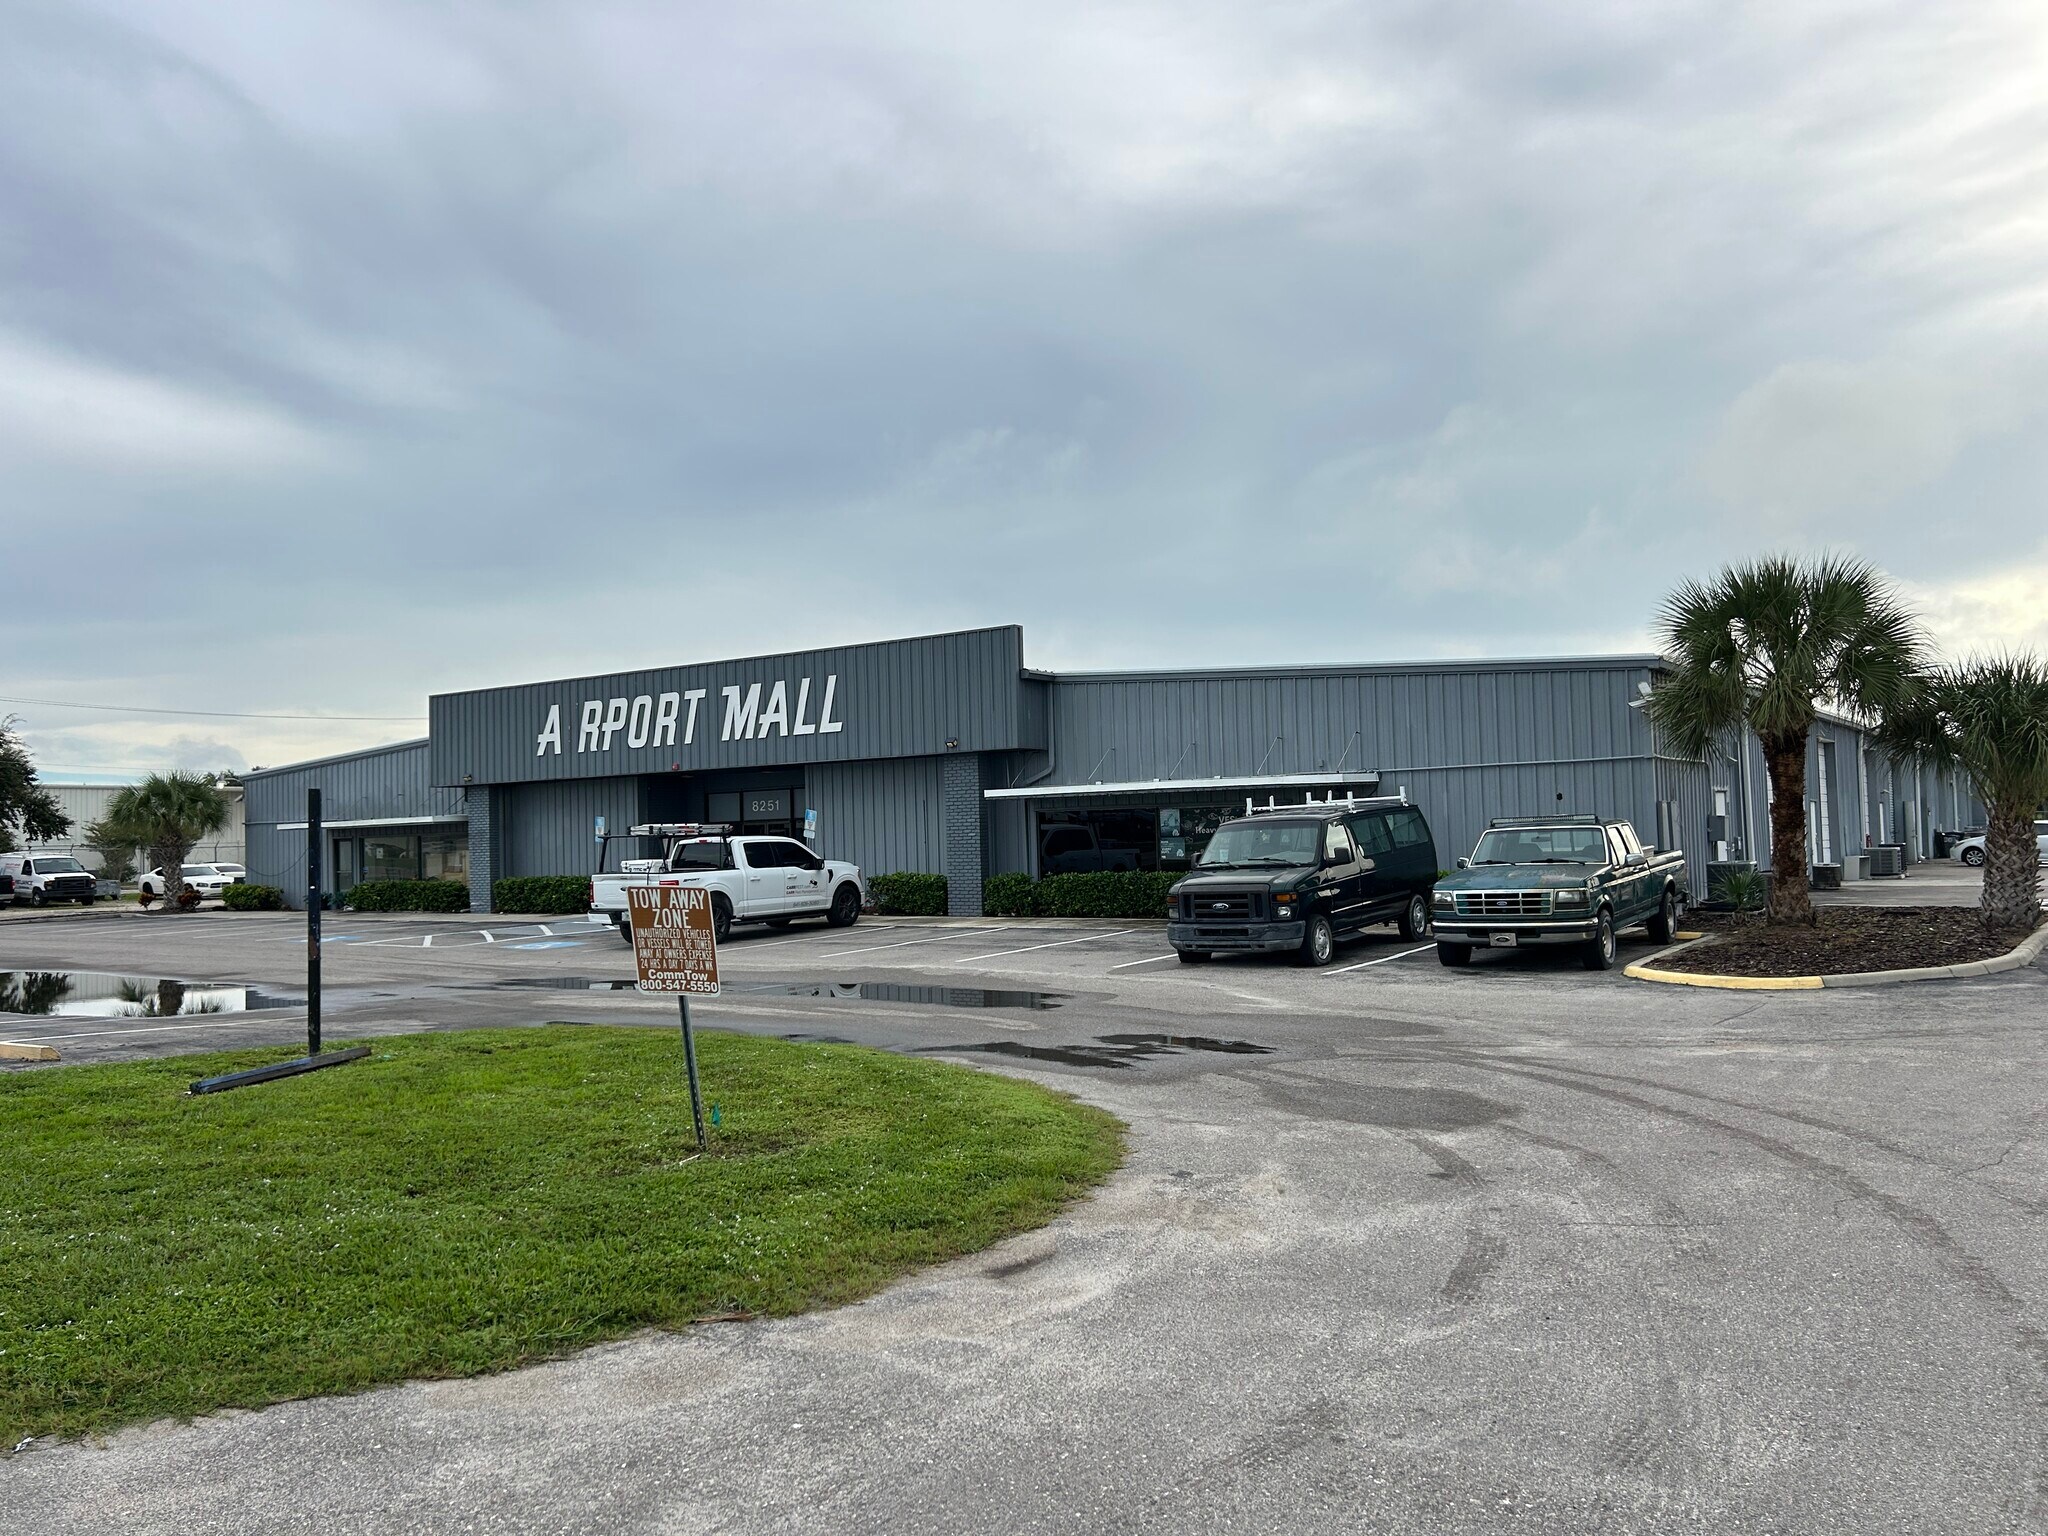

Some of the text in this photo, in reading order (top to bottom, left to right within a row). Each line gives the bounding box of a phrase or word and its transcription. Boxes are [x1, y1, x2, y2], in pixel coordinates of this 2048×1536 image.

[721, 674, 844, 742] MALL
[752, 799, 780, 812] 8251
[630, 888, 705, 910] TOW AWAY
[652, 908, 691, 929] ZONE
[636, 928, 711, 940] UNAUTHORIZED VEHICLES
[637, 938, 712, 950] OR VESSELS WILL BE TOWED
[639, 948, 713, 960] AWAY AT OWNERS EXPENSE
[641, 958, 714, 971] 24 HRS A DAY 7 DAYS A WK
[648, 969, 708, 981] CommTow
[640, 979, 718, 993] 800-547-5550
